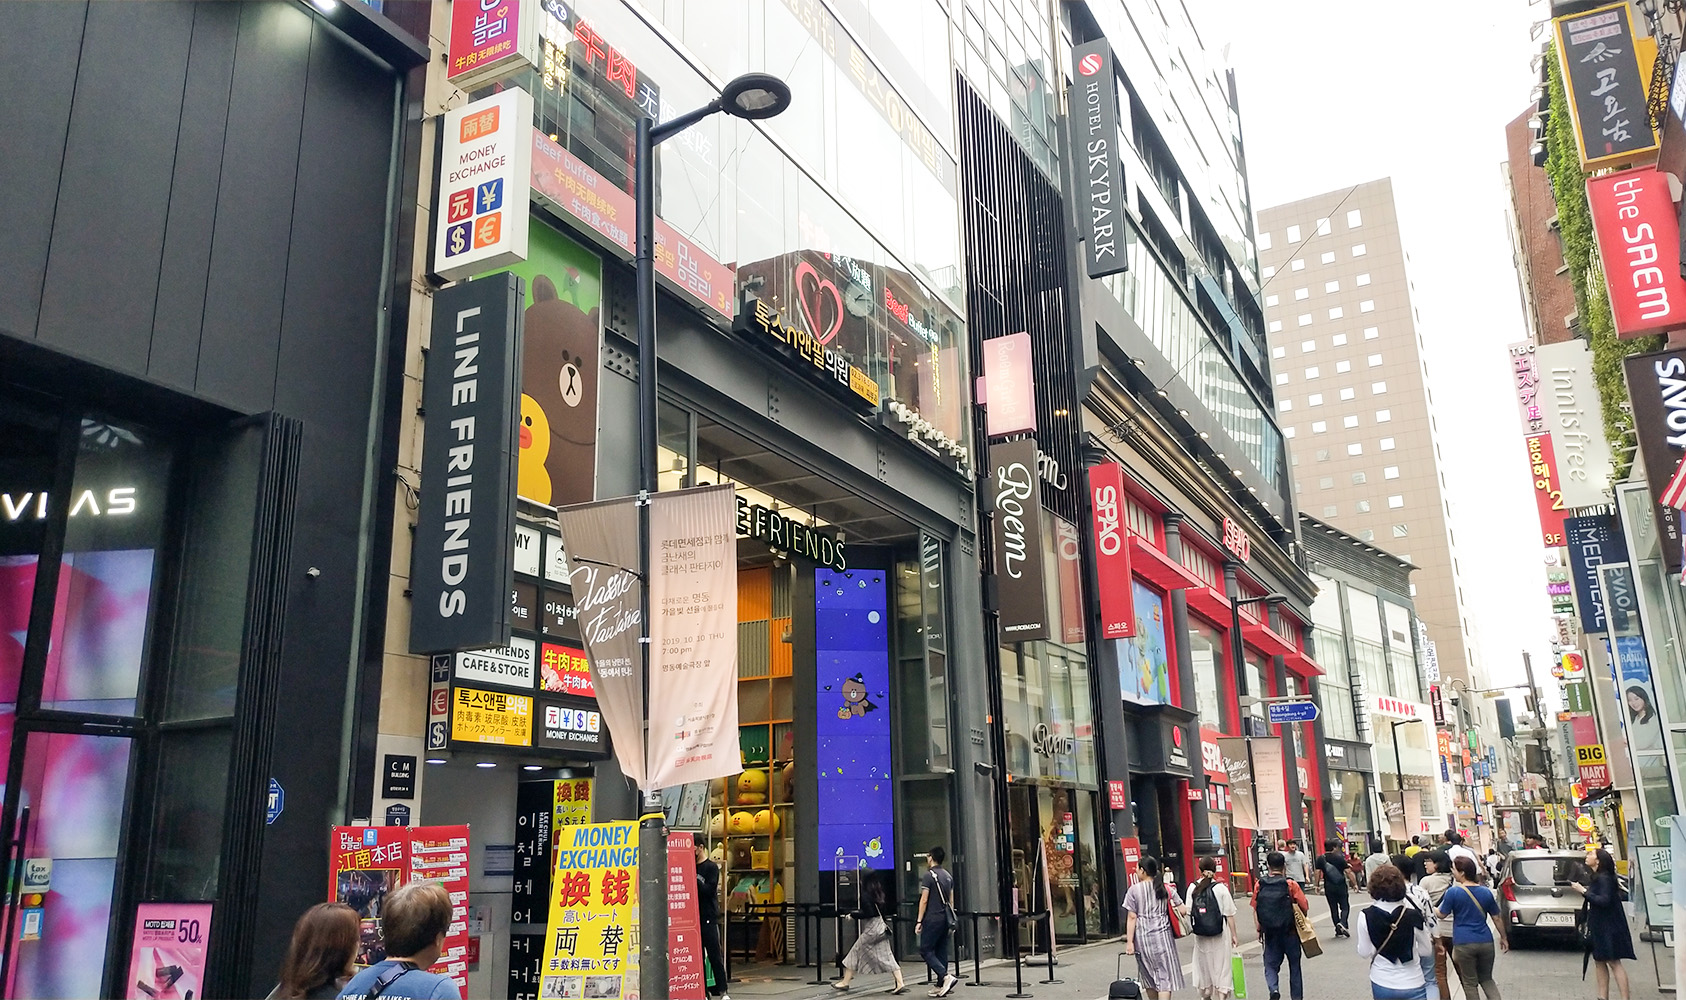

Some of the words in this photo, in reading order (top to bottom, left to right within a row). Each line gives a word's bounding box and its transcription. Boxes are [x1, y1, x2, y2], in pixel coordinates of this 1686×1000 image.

[1086, 80, 1102, 136] HOTEL
[459, 143, 498, 165] MONEY
[535, 135, 562, 162] Beef
[563, 156, 598, 188] buffet
[449, 155, 507, 184] EXCHANGE
[1087, 138, 1116, 263] SKYPARK
[1613, 177, 1644, 220] the
[451, 306, 482, 408] LINE
[1510, 343, 1536, 357] TBC
[1551, 367, 1592, 483] innisfree
[438, 415, 476, 620] FRIENDS
[996, 461, 1033, 580] Roem
[1095, 485, 1121, 556] SPAO
[756, 507, 847, 572] FRIENDS
[1545, 533, 1561, 545] 3F
[569, 565, 639, 612] Classic
[708, 632, 725, 641] THU
[1378, 697, 1416, 717] ARTBOX
[545, 729, 568, 741] MONEY
[568, 732, 599, 744] EXCHANGE
[1200, 740, 1227, 775] SPA
[1577, 747, 1603, 761] BIG
[1580, 765, 1606, 780] MART
[573, 825, 634, 848] MONEY
[31, 863, 47, 873] tax
[338, 841, 403, 874] 江南本店
[559, 846, 639, 870] EXCHANGE
[30, 872, 49, 881] free
[562, 908, 619, 925] 高いレート
[549, 958, 621, 971] 手数料無いです
